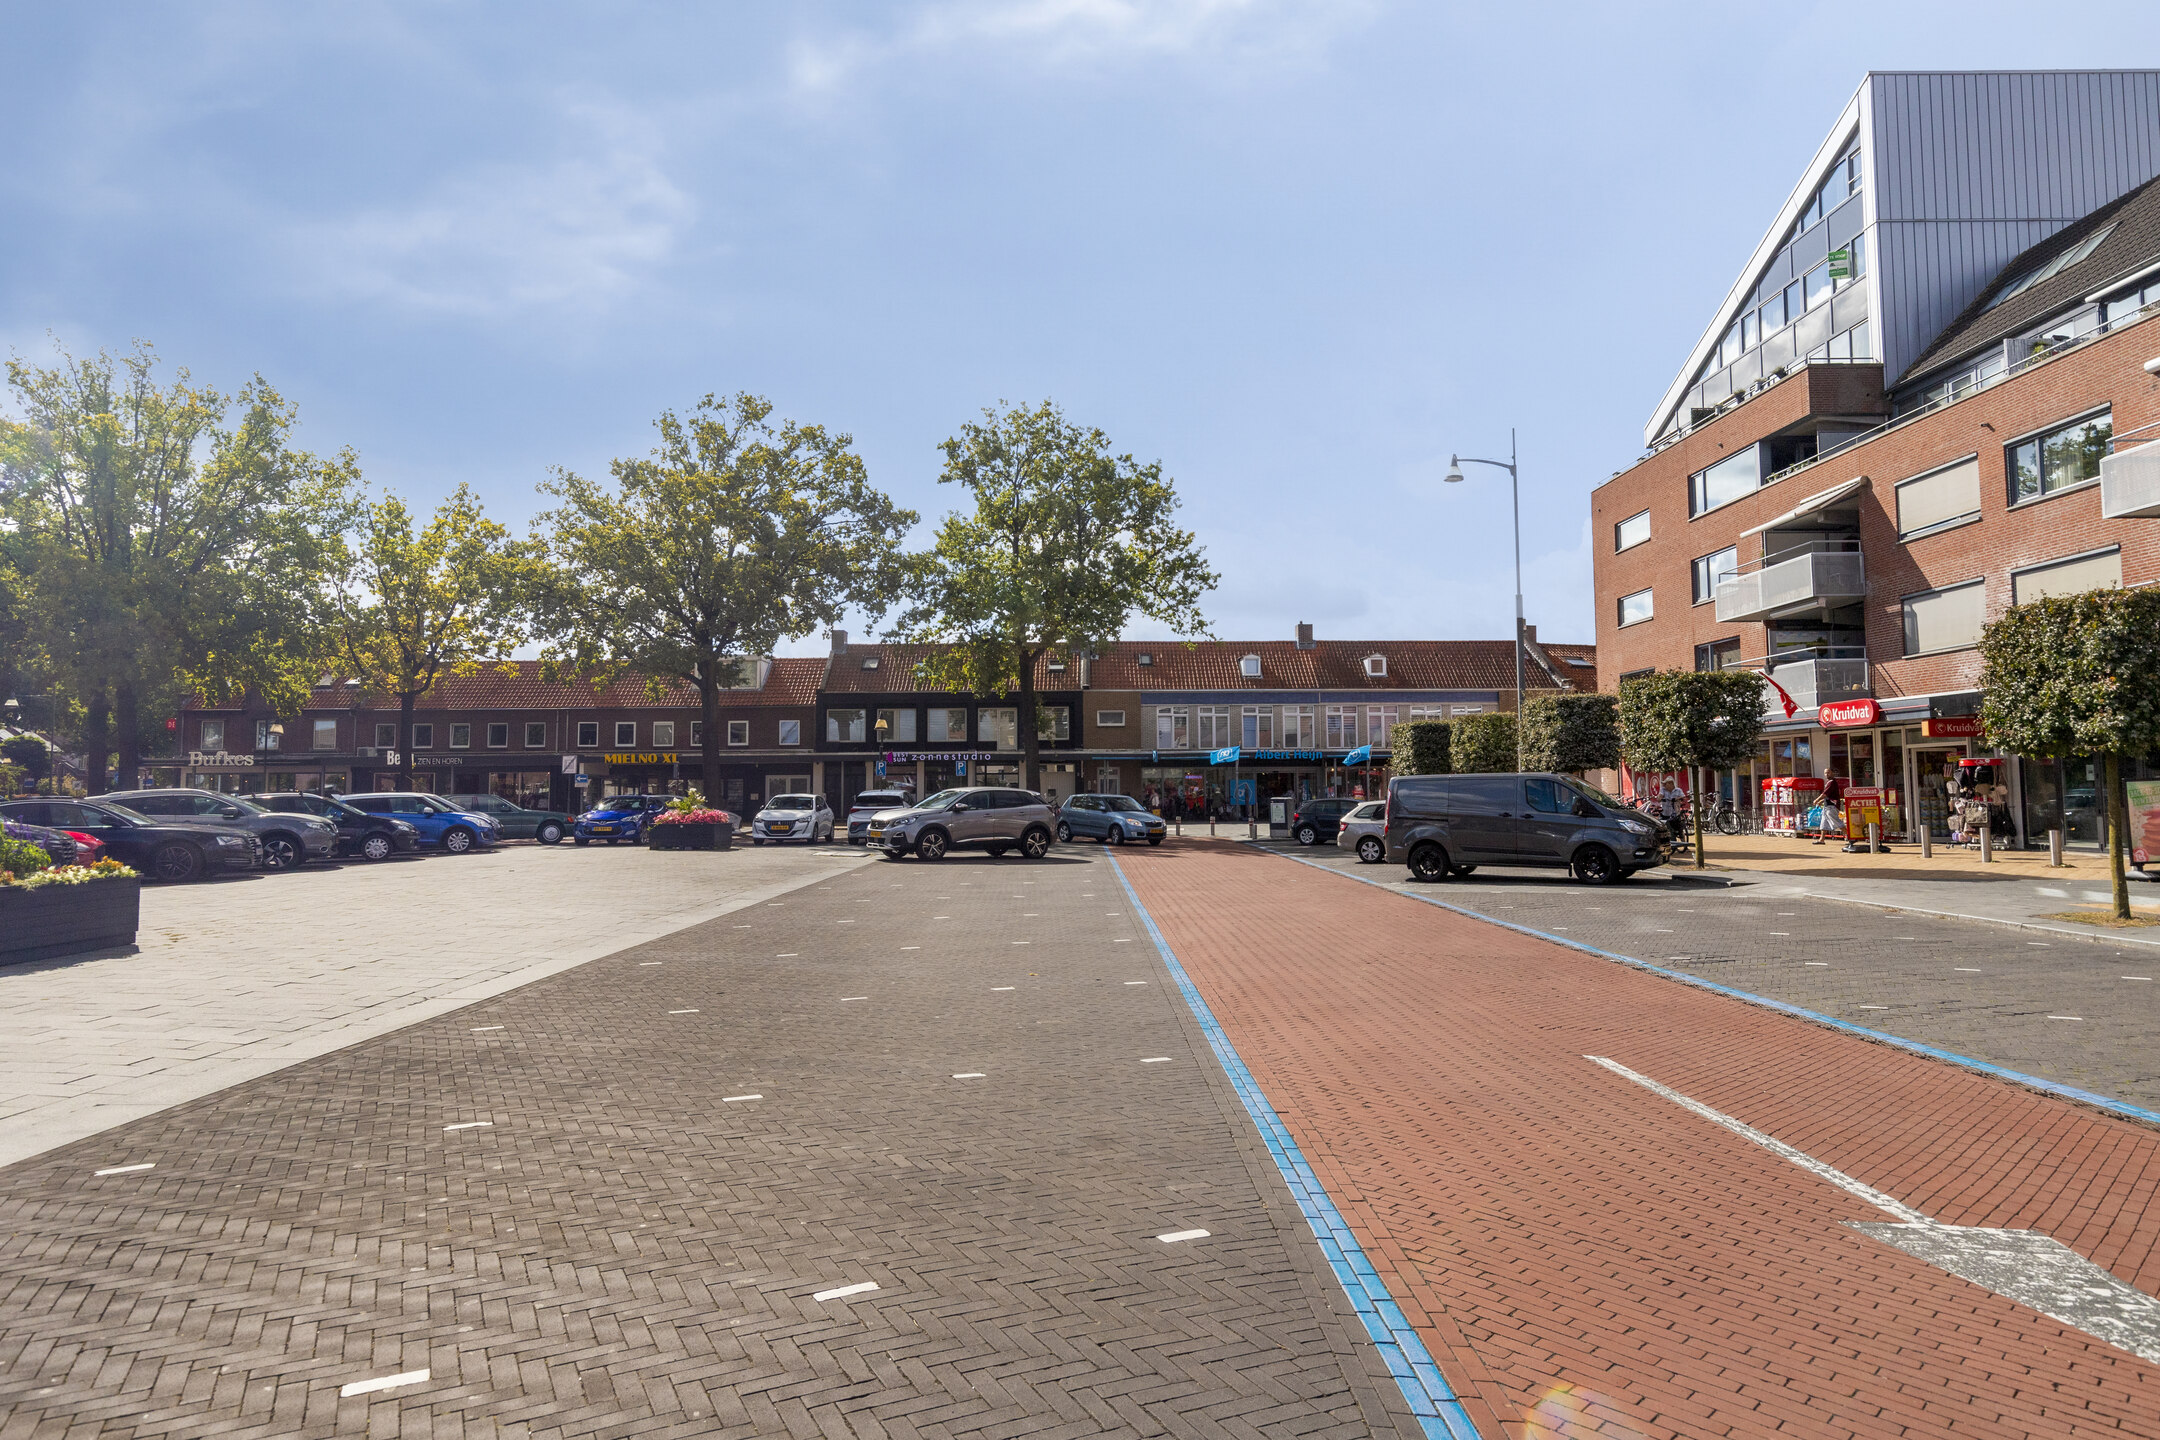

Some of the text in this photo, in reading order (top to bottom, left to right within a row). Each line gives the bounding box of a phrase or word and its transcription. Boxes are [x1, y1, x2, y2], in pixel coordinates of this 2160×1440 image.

[1832, 705, 1869, 721] Kruidvat
[189, 751, 254, 767] Bufkes
[604, 753, 680, 764] MIELNO XL
[912, 750, 991, 761] zonnestudio
[1255, 749, 1323, 761] Albert Heijn
